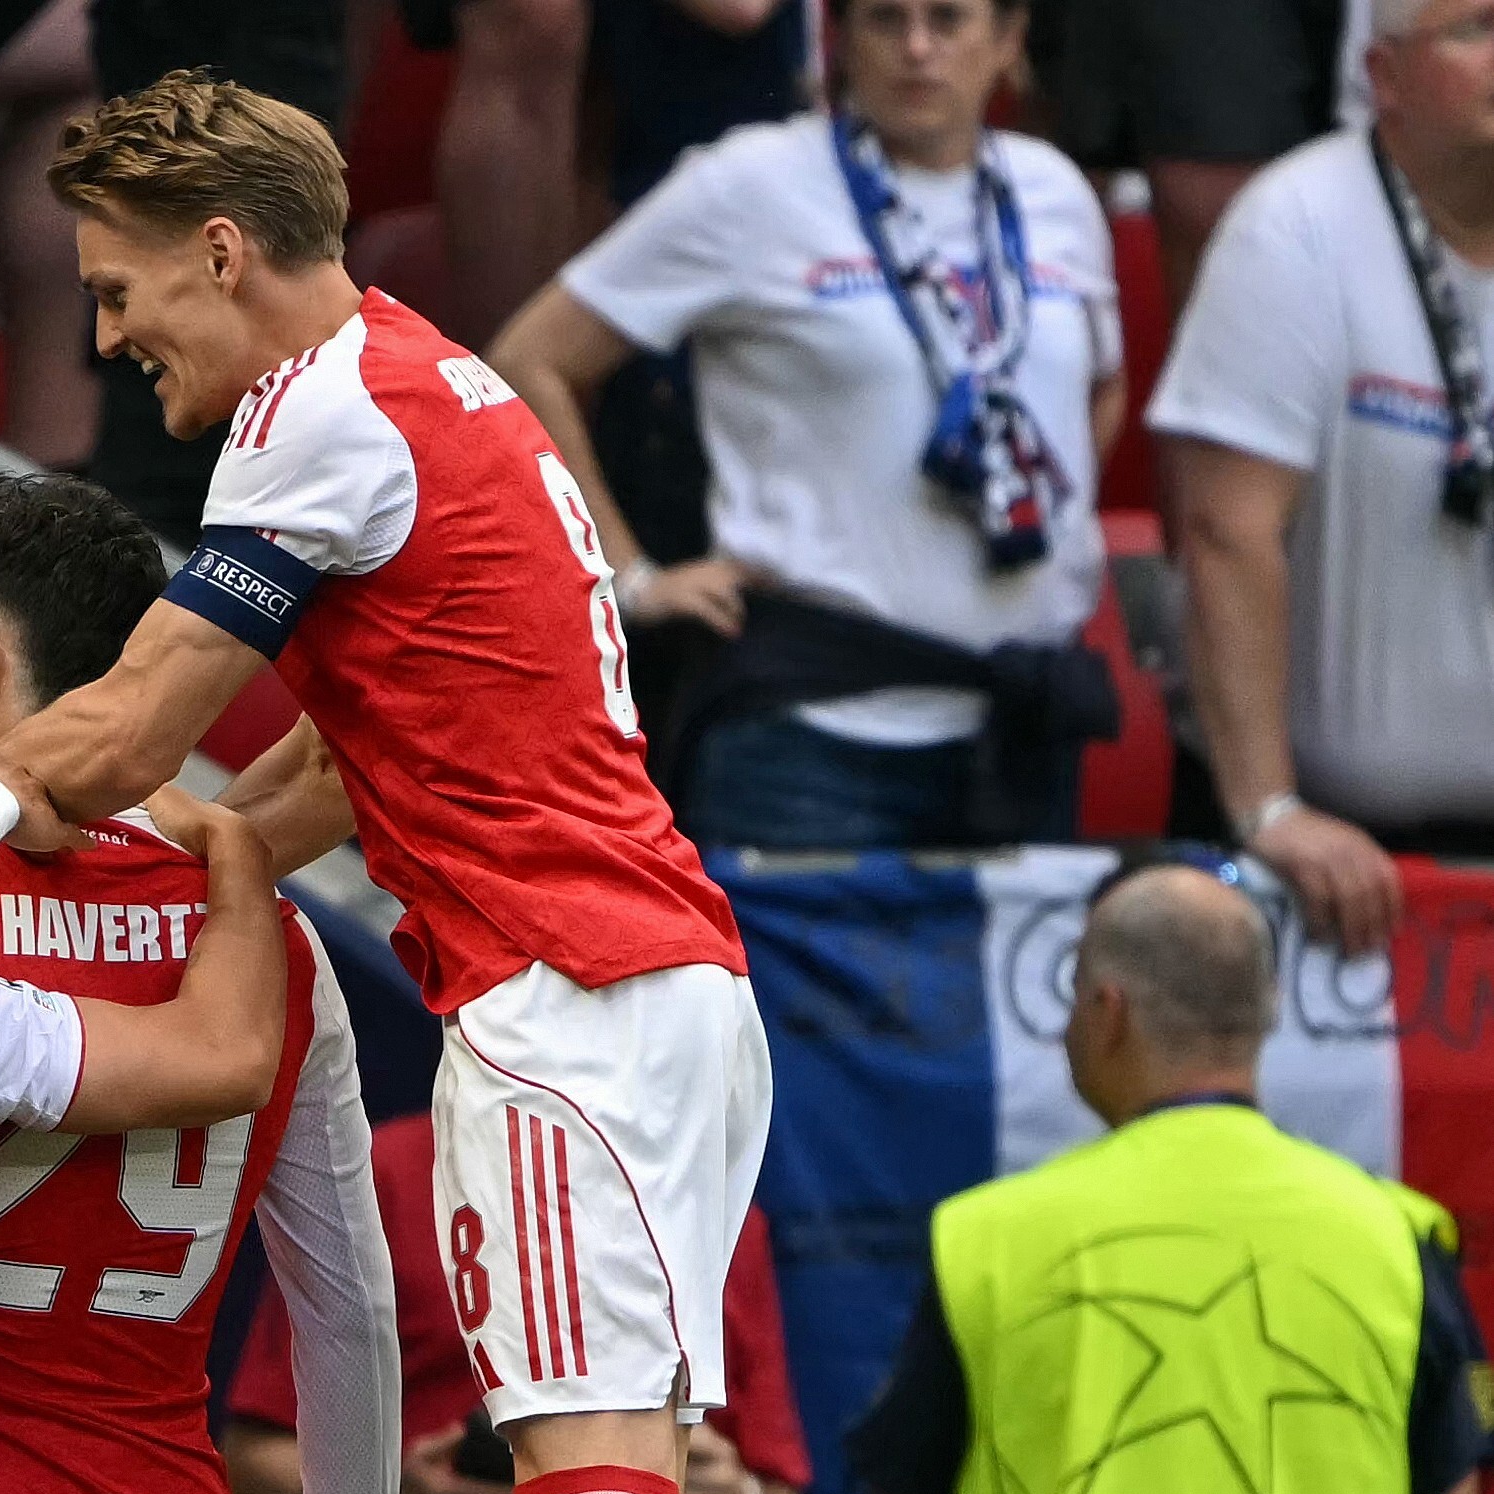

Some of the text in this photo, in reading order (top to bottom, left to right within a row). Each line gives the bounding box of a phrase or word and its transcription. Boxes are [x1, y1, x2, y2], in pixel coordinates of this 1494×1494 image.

[212, 561, 293, 616] RESPECT
[535, 452, 639, 739] 8
[0, 893, 207, 962] HAVERT
[450, 1202, 493, 1336] 8
